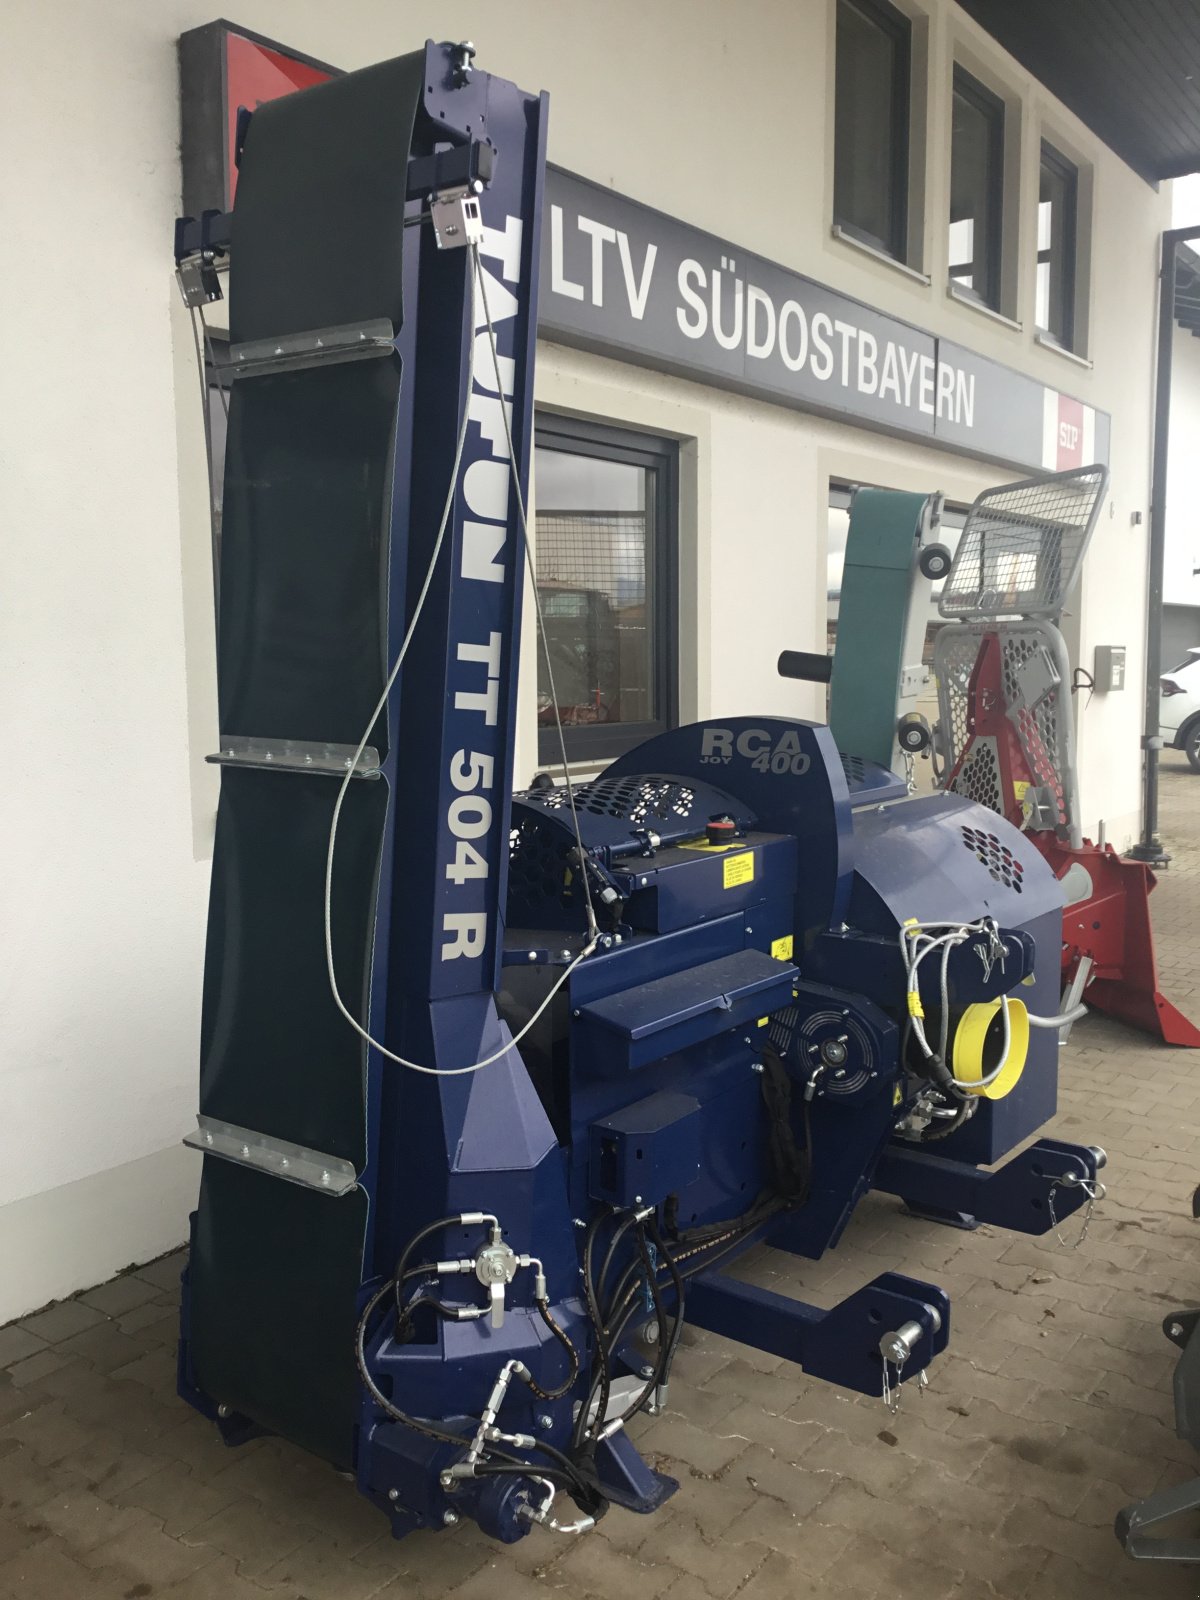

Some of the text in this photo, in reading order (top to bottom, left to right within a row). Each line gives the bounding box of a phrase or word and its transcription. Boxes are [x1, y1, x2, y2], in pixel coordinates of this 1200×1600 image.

[551, 204, 976, 428] LTV SÜDOSTBAYERN
[1060, 421, 1078, 450] SIP
[441, 215, 523, 962] TAJFUN TT 504 R
[701, 728, 802, 758] RCA
[699, 756, 732, 765] JOY
[751, 751, 811, 776] 400
